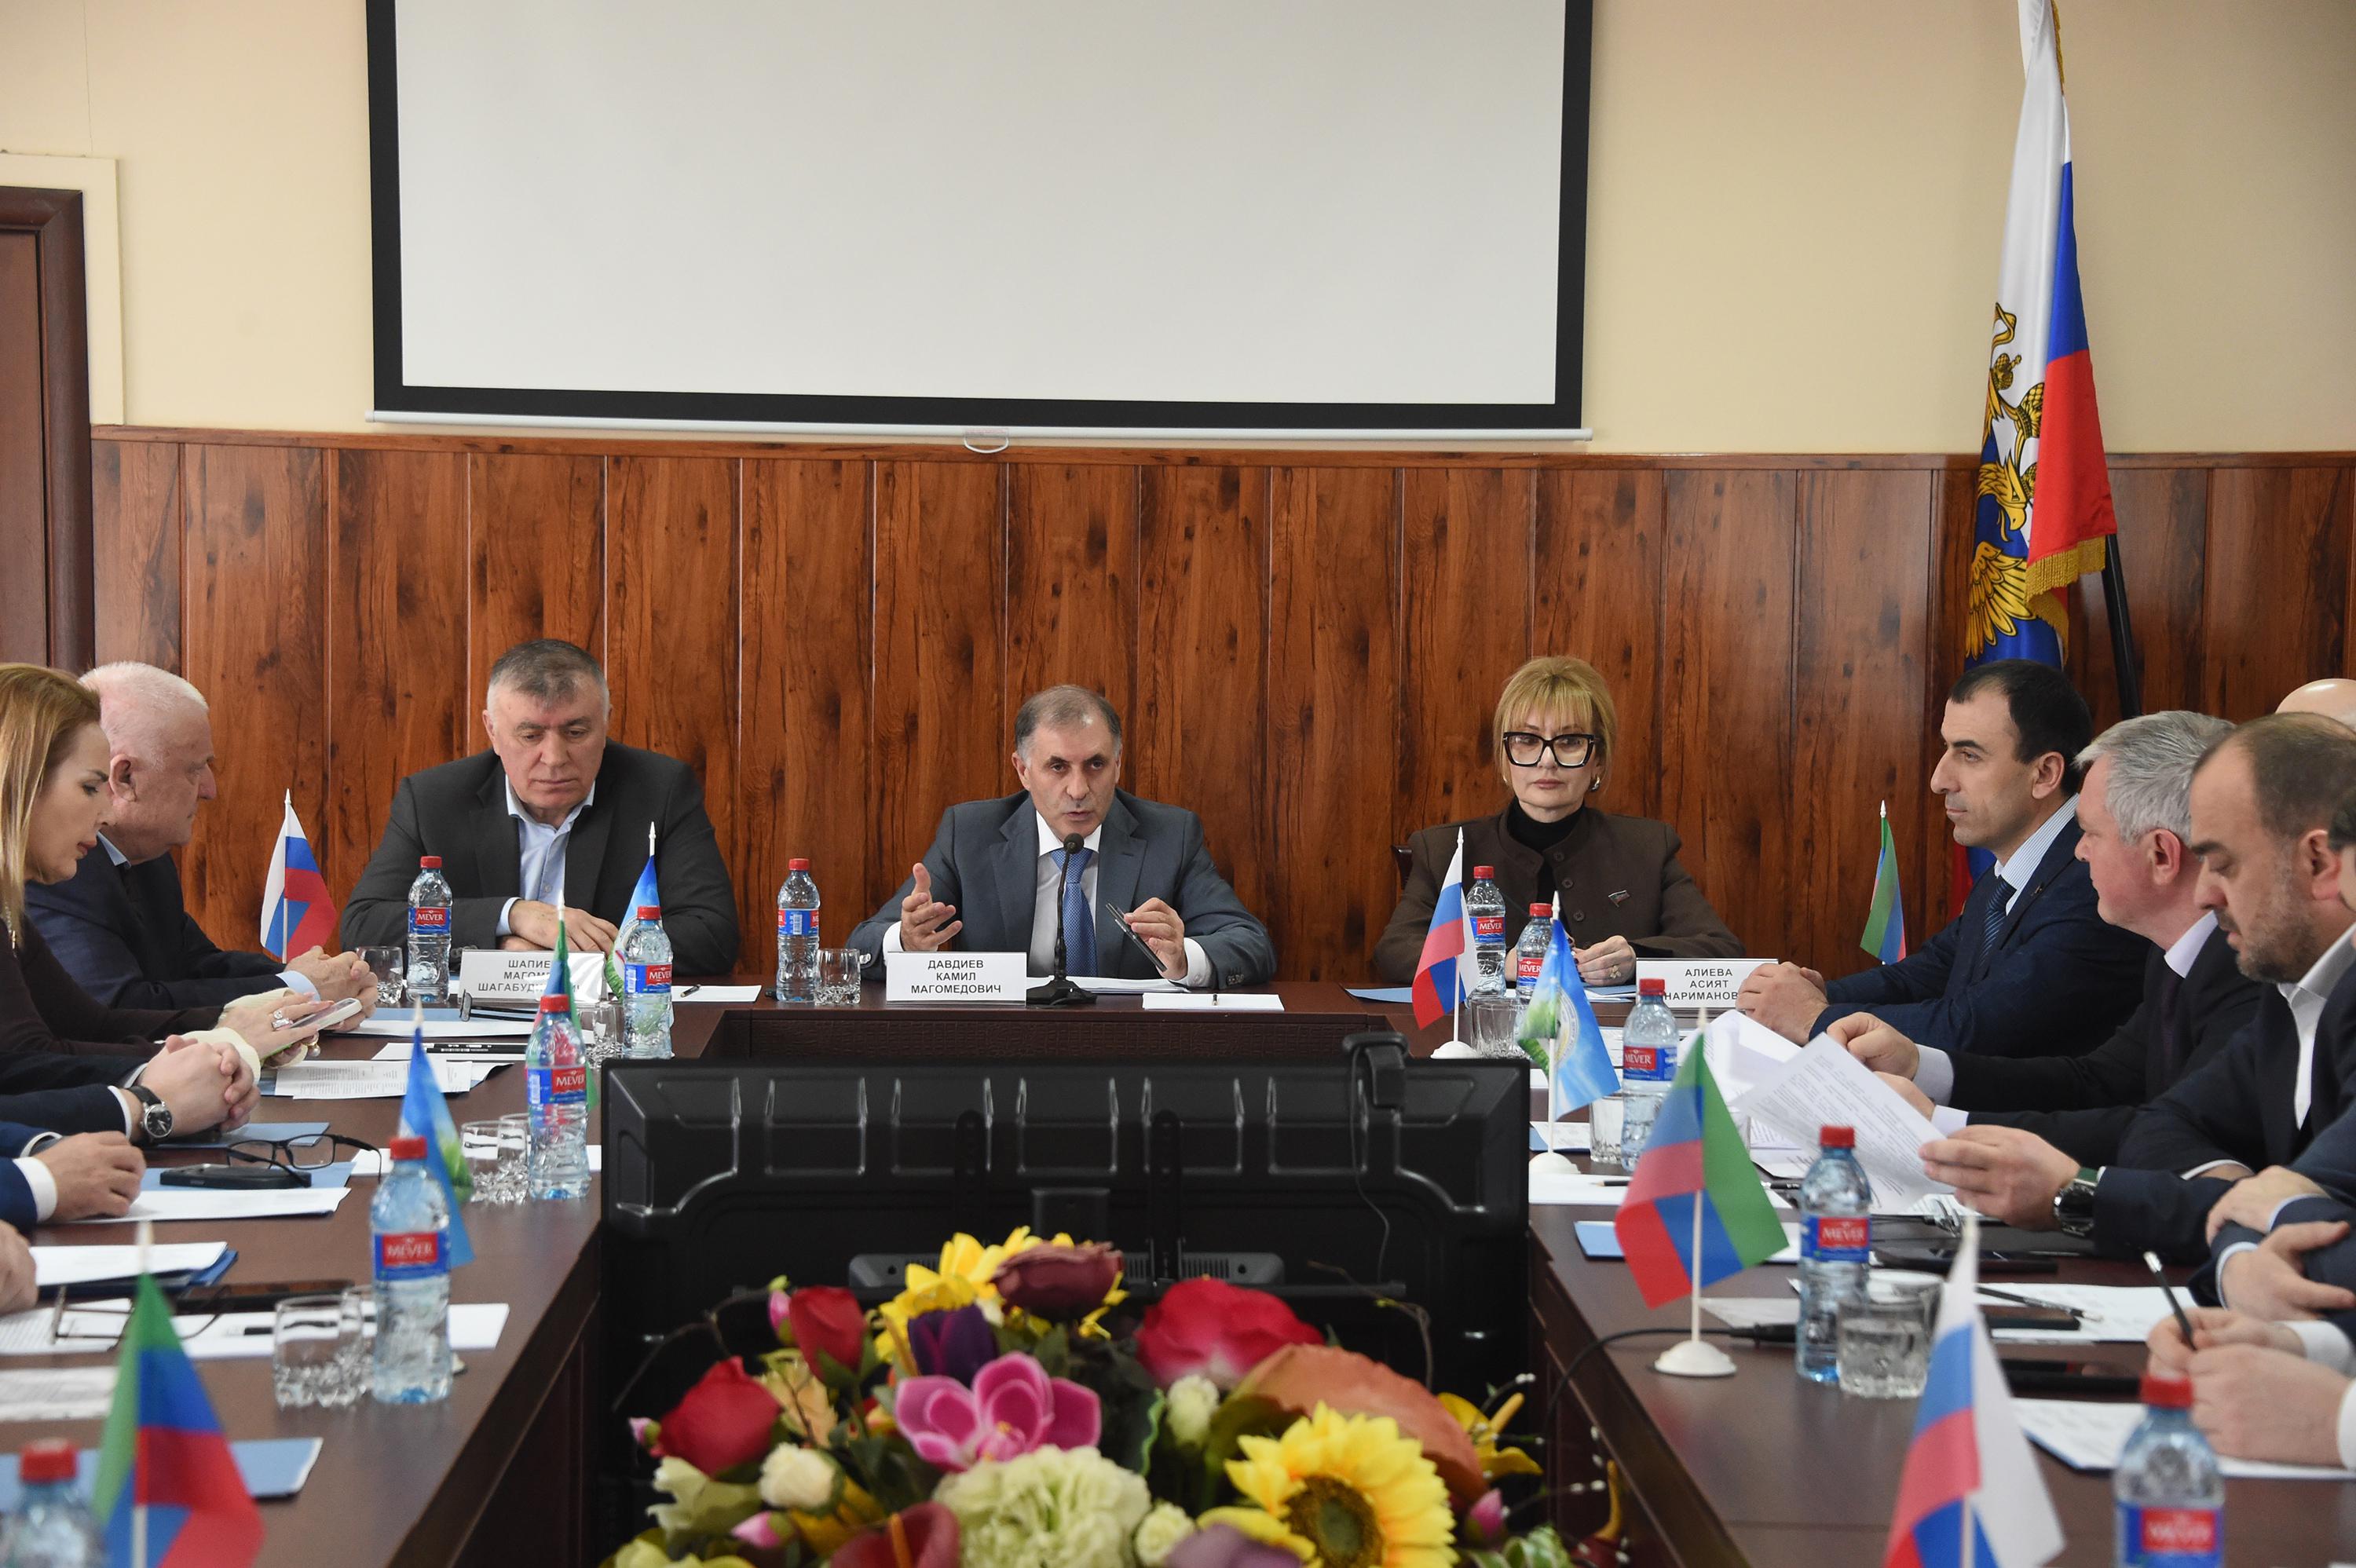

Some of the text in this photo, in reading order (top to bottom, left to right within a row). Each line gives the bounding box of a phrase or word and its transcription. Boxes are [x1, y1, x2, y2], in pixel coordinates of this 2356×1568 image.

[508, 959, 551, 969] ШАПИЕ
[927, 959, 984, 970] ДАВДИЕВ
[936, 972, 976, 981] КАМИЛ
[1685, 968, 1733, 977] АЛИЕВА
[1689, 980, 1729, 989] АСИЯТ
[911, 985, 1001, 995] МАГОМЕДОВИЧ
[1664, 992, 1738, 1001] НАРИМАНОВ
[1624, 1054, 1652, 1065] MEVER
